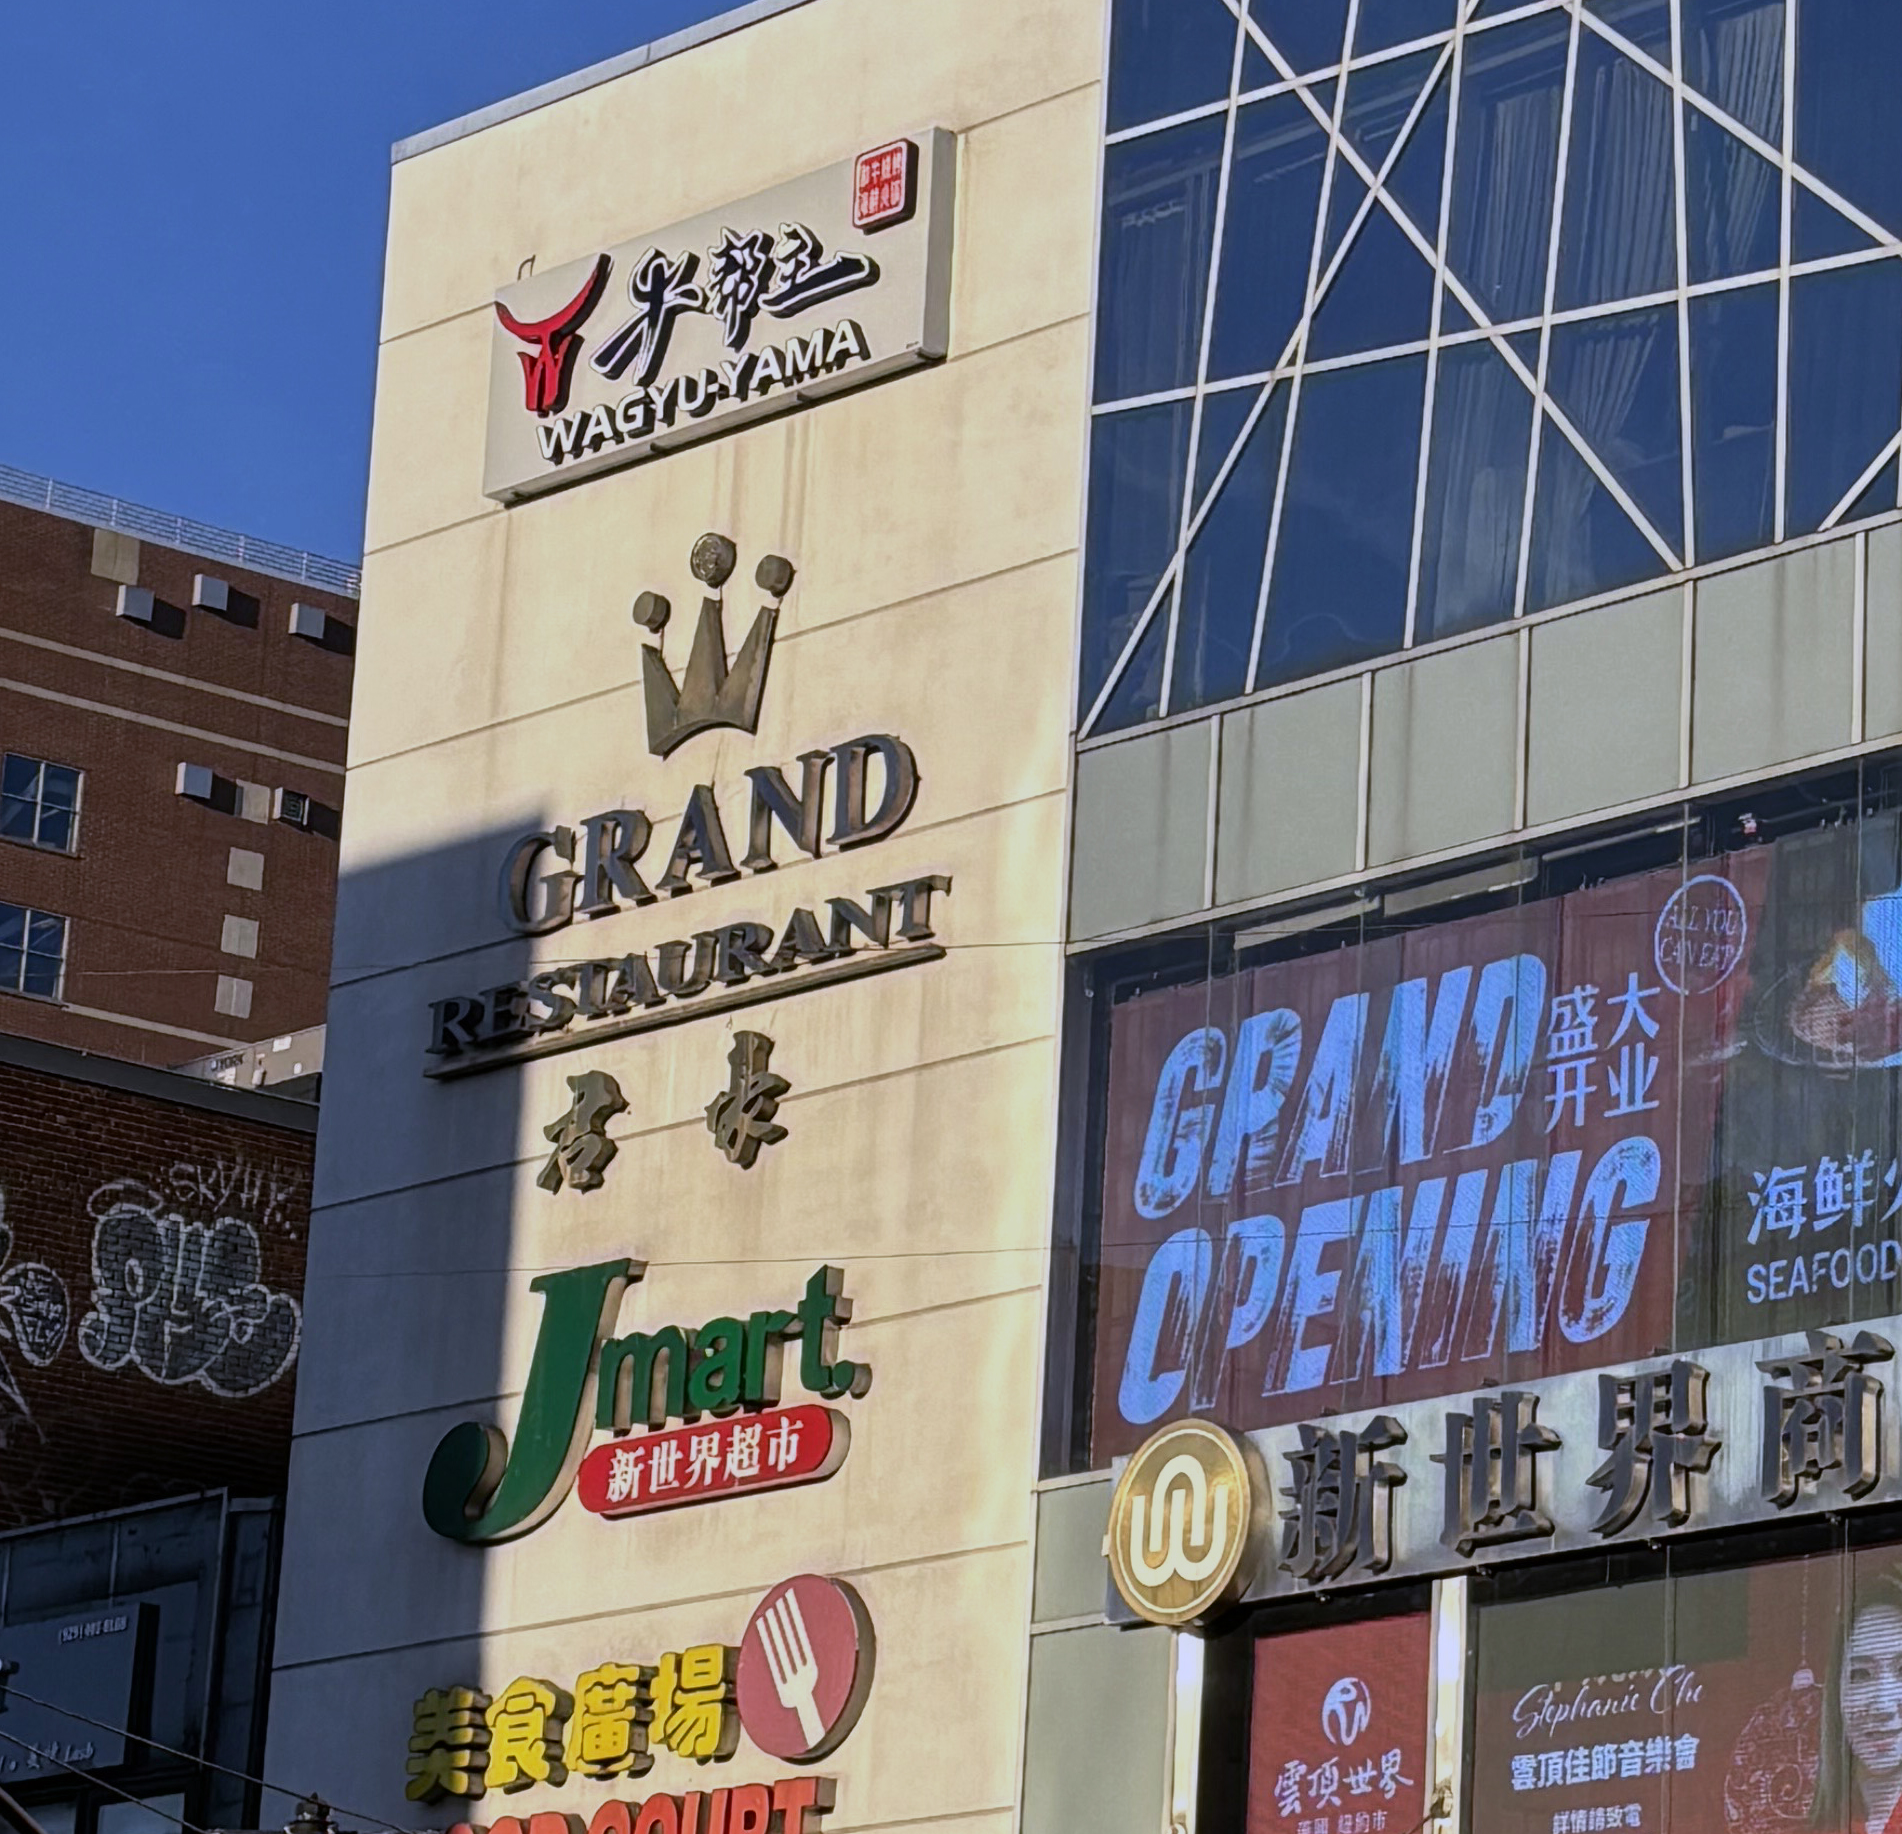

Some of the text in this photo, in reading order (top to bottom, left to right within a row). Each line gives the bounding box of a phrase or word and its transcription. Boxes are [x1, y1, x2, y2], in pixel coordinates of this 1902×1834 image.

[536, 318, 870, 464] WAGYU-YAMA
[502, 732, 921, 937] GRAND
[427, 874, 953, 1057] RESTAURANT
[1666, 905, 1740, 936] ALL YOU
[1134, 953, 1546, 1221] GRAND
[1118, 1136, 1661, 1425] OPENING
[1746, 1238, 1902, 1307] SEAFOOD
[422, 1258, 853, 1543] Jmart
[605, 1417, 805, 1504] 新世界超市
[405, 1642, 740, 1805] 美食廣場
[1274, 1747, 1414, 1818] 雲頂世界
[1511, 1732, 1700, 1791] 雲頂佳節音樂會
[1512, 1681, 1640, 1739] Stephanie
